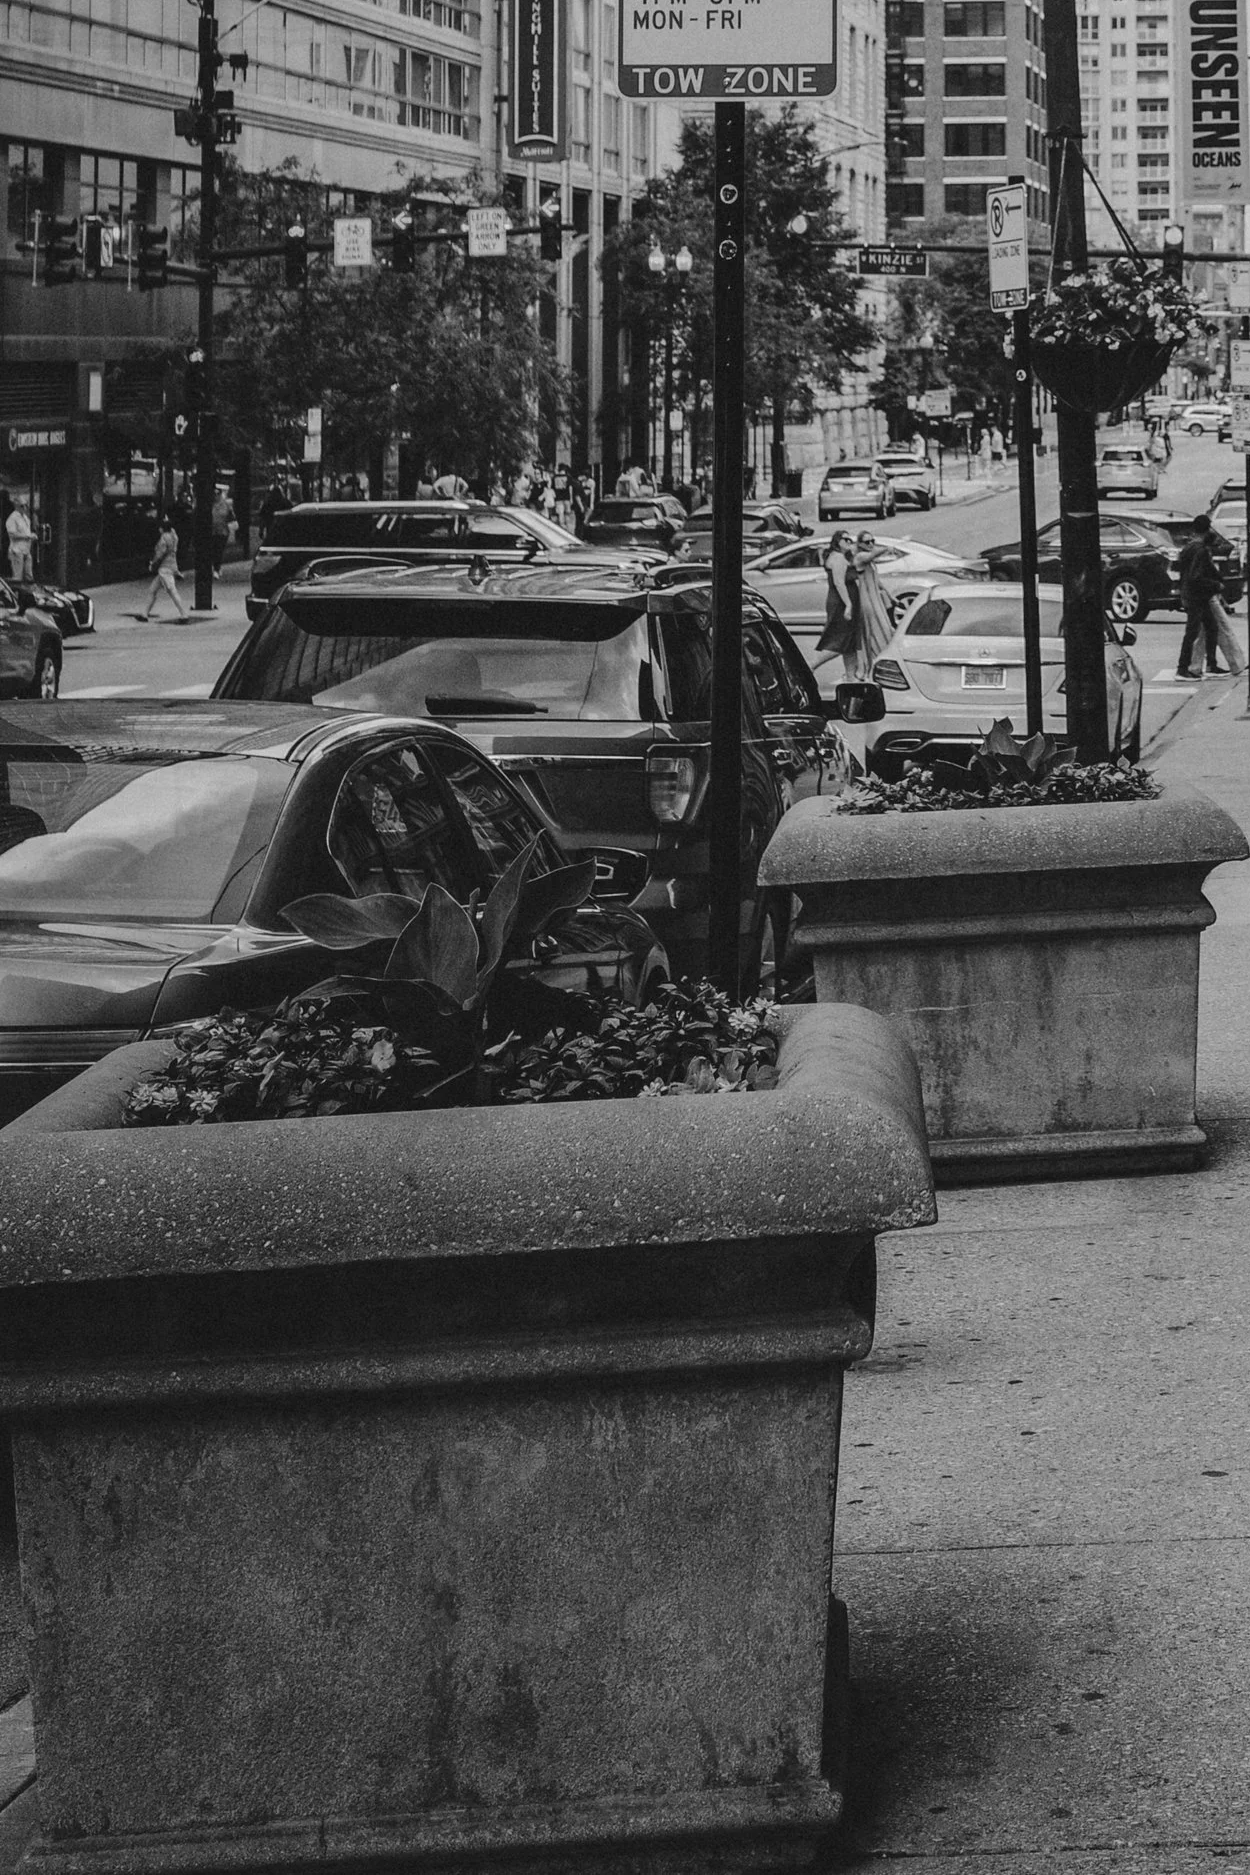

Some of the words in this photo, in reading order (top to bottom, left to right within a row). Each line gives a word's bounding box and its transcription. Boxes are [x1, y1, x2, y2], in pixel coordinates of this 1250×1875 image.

[633, 9, 684, 30] MON
[706, 9, 742, 30] FRI
[632, 67, 705, 94] TOW
[724, 66, 818, 94] ZONE
[1189, 0, 1241, 149] UNSEEN
[531, 68, 542, 134] SUITES
[1192, 151, 1242, 168] OCEANS
[868, 253, 914, 266] KINZIE
